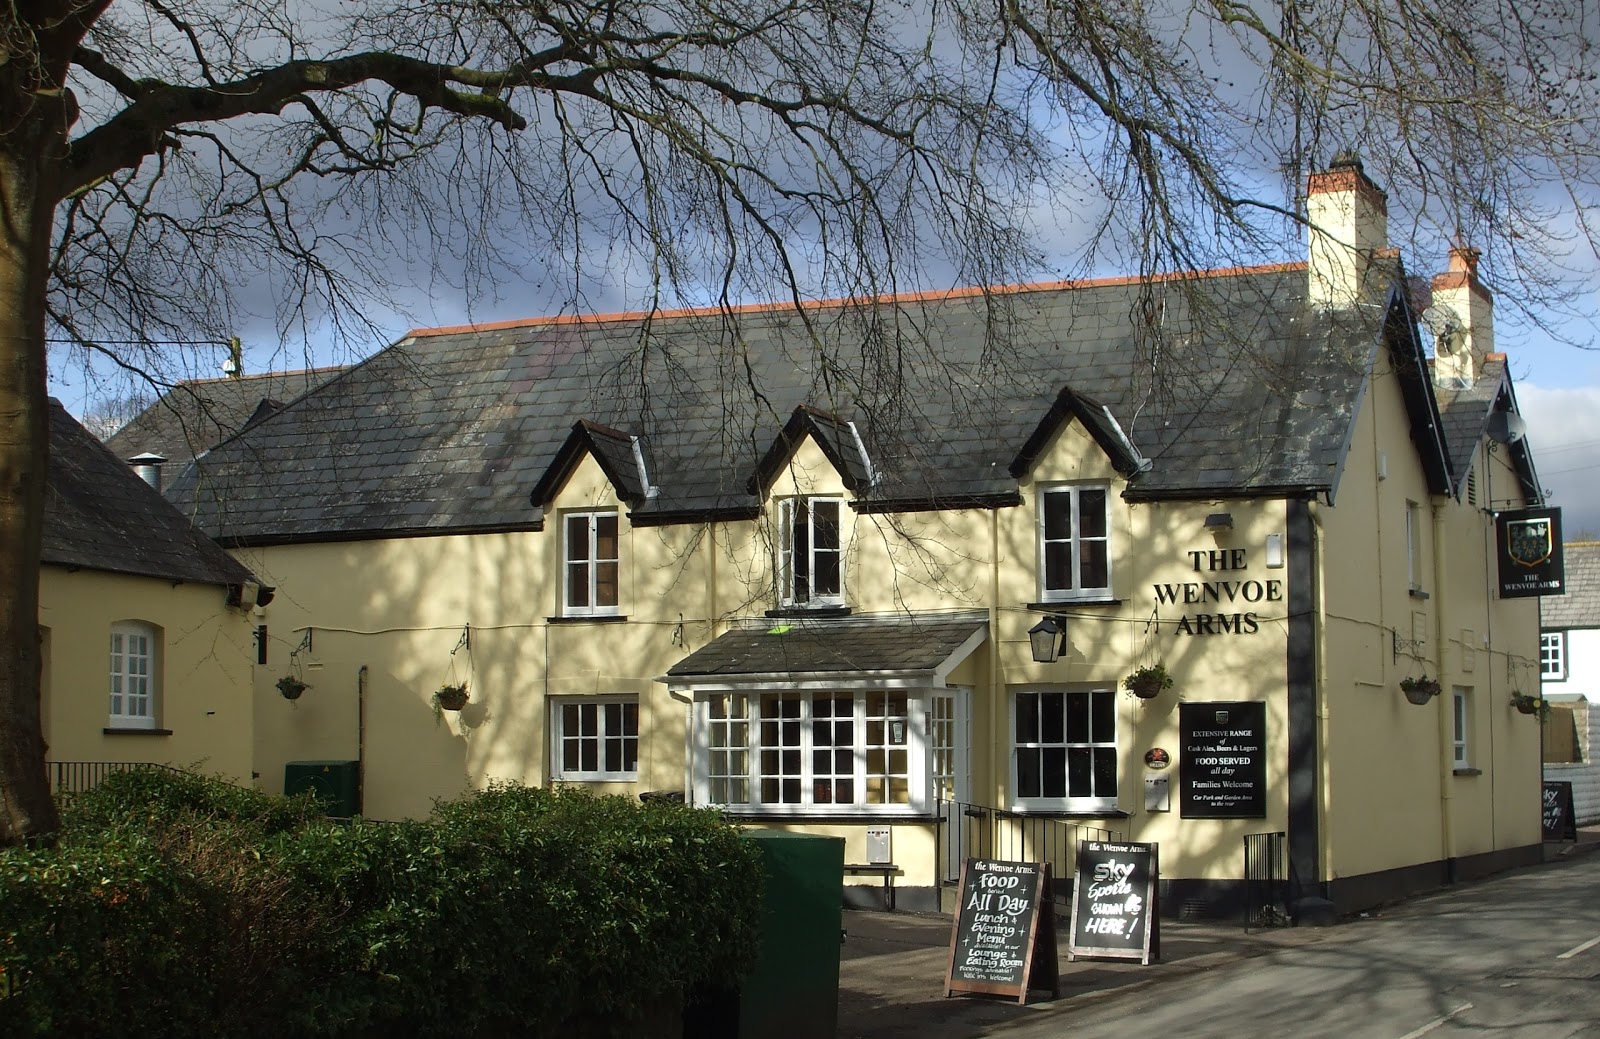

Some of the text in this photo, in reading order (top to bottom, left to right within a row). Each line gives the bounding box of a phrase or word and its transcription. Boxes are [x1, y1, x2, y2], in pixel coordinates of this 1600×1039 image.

[1187, 548, 1248, 572] THE
[1504, 580, 1560, 591] WENVOE ARMS
[1153, 579, 1283, 606] WENVOE
[1174, 612, 1259, 635] ARMS
[1195, 757, 1251, 765] FOOD SERVED
[1210, 767, 1236, 776] all day
[1192, 780, 1254, 789] Families Welcome
[1089, 843, 1100, 851] the
[1103, 844, 1128, 852] Wenvoe
[974, 861, 986, 871] the
[989, 863, 1014, 872] Wenvoe
[1088, 882, 1132, 901] Sports
[967, 891, 1029, 916] All Day
[974, 913, 1009, 924] Lunch
[971, 922, 1015, 937] Evening
[976, 932, 1006, 944] Menu
[968, 948, 1008, 960] Lounge
[966, 956, 1023, 968] Eating Room
